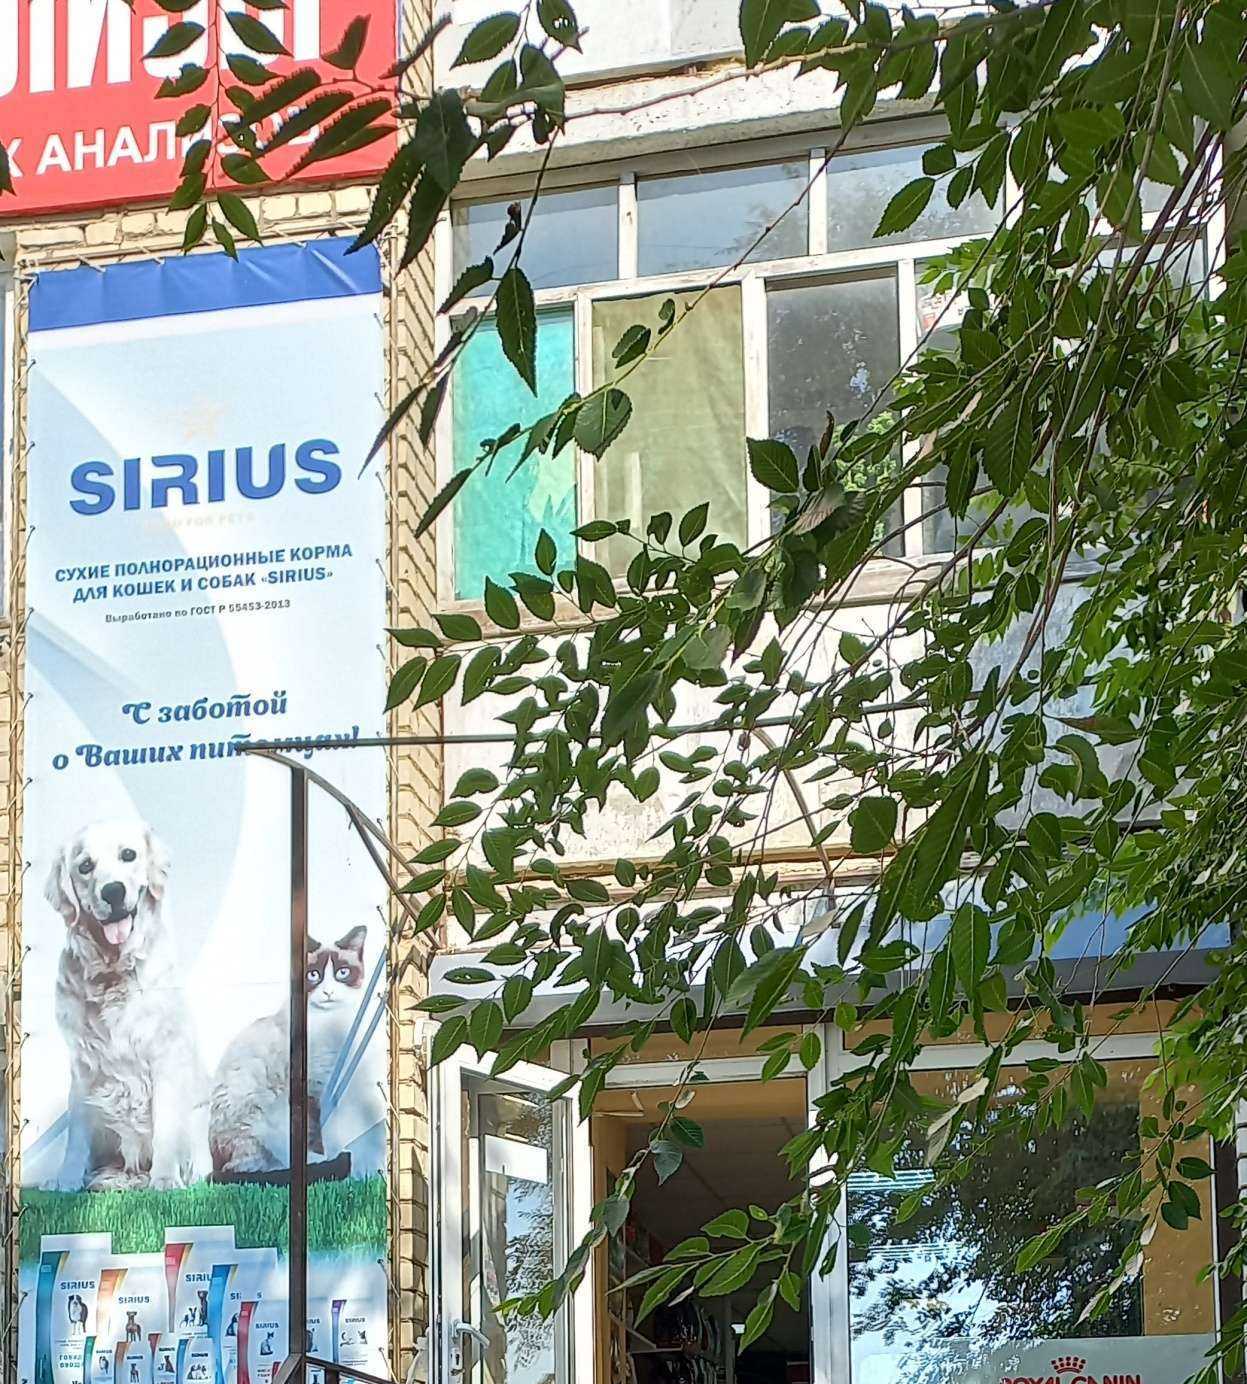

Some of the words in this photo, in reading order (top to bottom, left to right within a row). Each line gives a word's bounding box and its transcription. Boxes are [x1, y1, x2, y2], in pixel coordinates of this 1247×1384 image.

[69, 439, 342, 516] SIRIUS
[55, 564, 110, 582] СУХИЕ
[114, 549, 286, 577] ПОЛНОРАЦИОННЫЕ
[290, 543, 353, 562] КОРМА
[73, 585, 108, 603] ДЛЯ
[113, 578, 176, 599] КОШЕК
[182, 577, 193, 593] И
[197, 572, 256, 591] СОБАК
[261, 566, 334, 586] «SIRIUS»
[105, 611, 173, 624] Выработано
[190, 605, 216, 616] ГОСТ
[122, 701, 151, 725] С
[158, 689, 288, 723] заботой
[52, 753, 69, 770] о
[76, 743, 184, 769] Ваших
[60, 1281, 95, 1290] SIRIUS
[118, 1296, 150, 1304] SIRIUS
